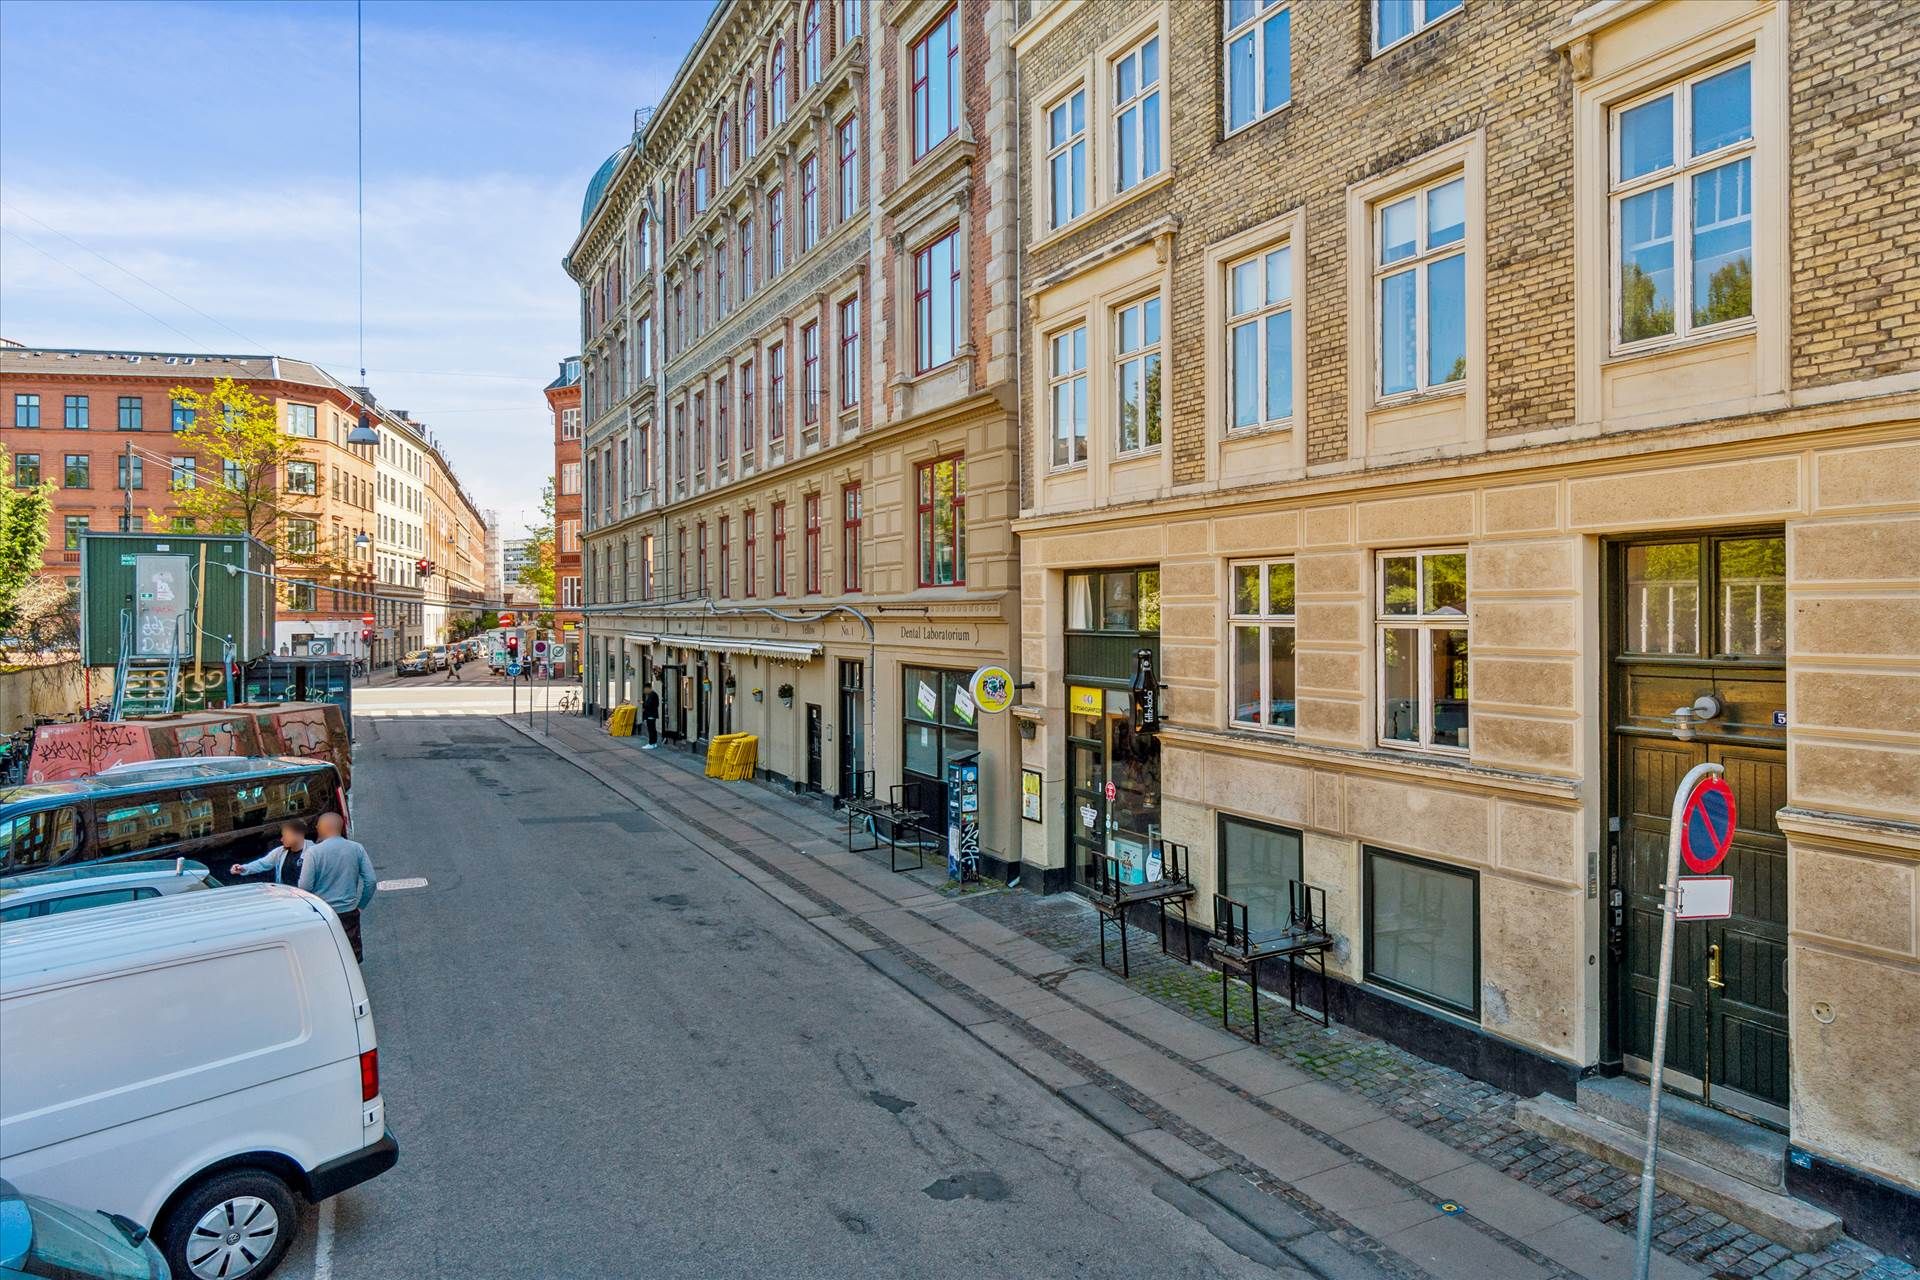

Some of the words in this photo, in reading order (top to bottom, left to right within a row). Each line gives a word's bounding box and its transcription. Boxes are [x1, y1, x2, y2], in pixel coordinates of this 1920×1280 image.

[900, 626, 921, 639] Dental
[923, 626, 970, 641] Laboratorium
[1777, 713, 1786, 724] 5
